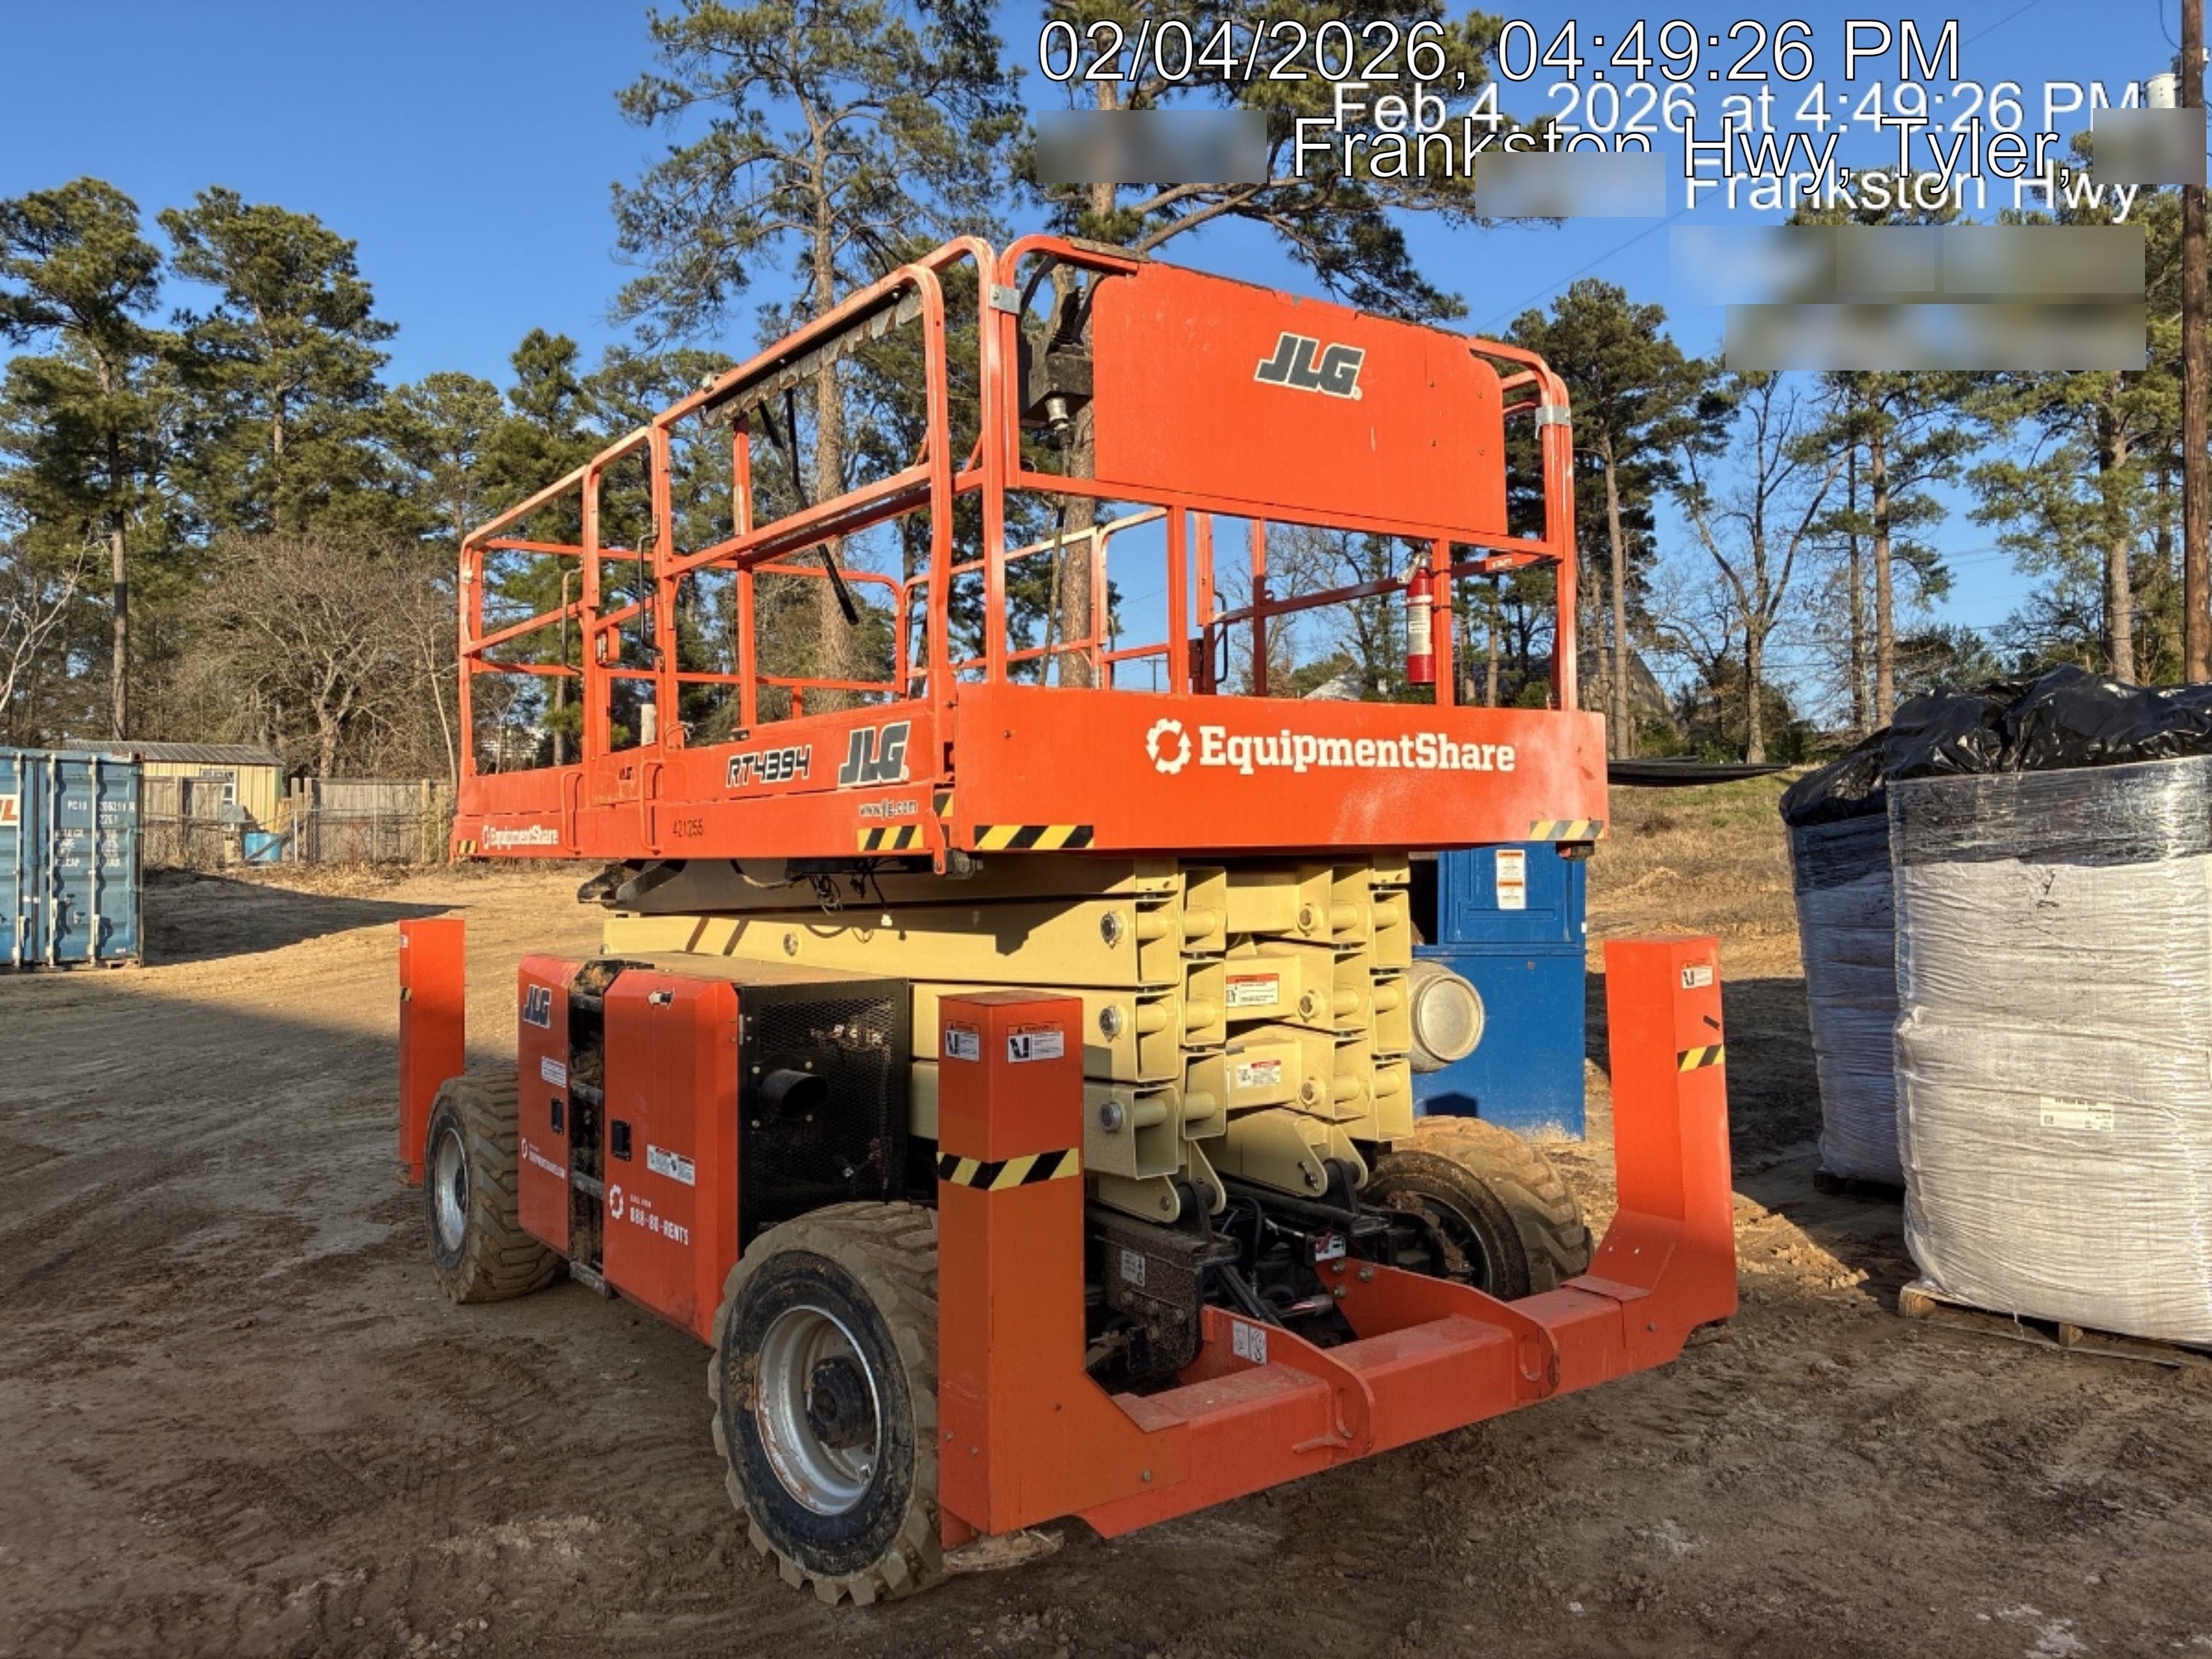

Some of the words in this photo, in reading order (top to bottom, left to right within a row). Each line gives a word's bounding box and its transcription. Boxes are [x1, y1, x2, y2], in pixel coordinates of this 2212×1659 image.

[1253, 331, 1366, 400] JLG
[726, 743, 813, 788] RT4394
[837, 720, 912, 788] JLG
[1199, 725, 1516, 775] EquipmentShare
[490, 824, 559, 850] EquipmentShare
[523, 984, 552, 1029] JLG
